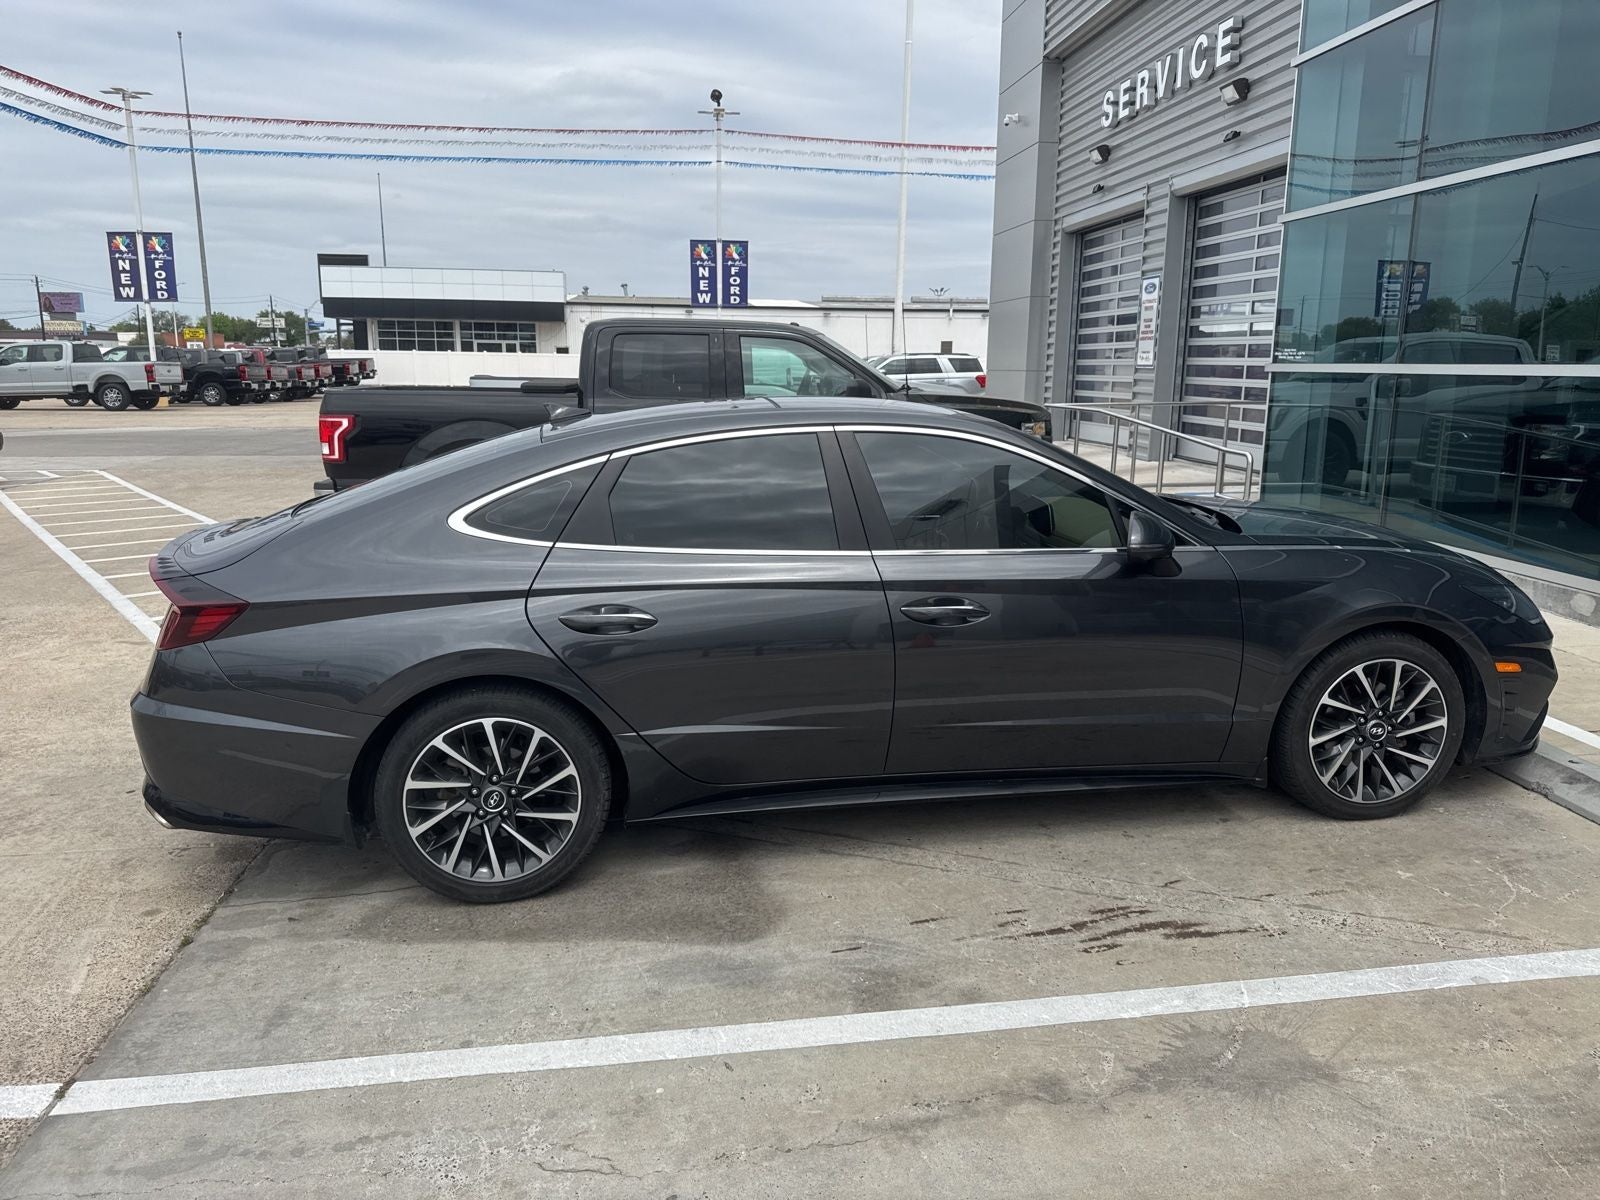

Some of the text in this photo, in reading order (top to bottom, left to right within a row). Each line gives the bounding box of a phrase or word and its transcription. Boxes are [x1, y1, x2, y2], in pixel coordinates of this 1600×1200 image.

[1101, 15, 1242, 128] SERVICE
[118, 259, 135, 298] NEW
[154, 260, 168, 299] FORD
[697, 266, 711, 304] NEW
[729, 266, 741, 304] FORD
